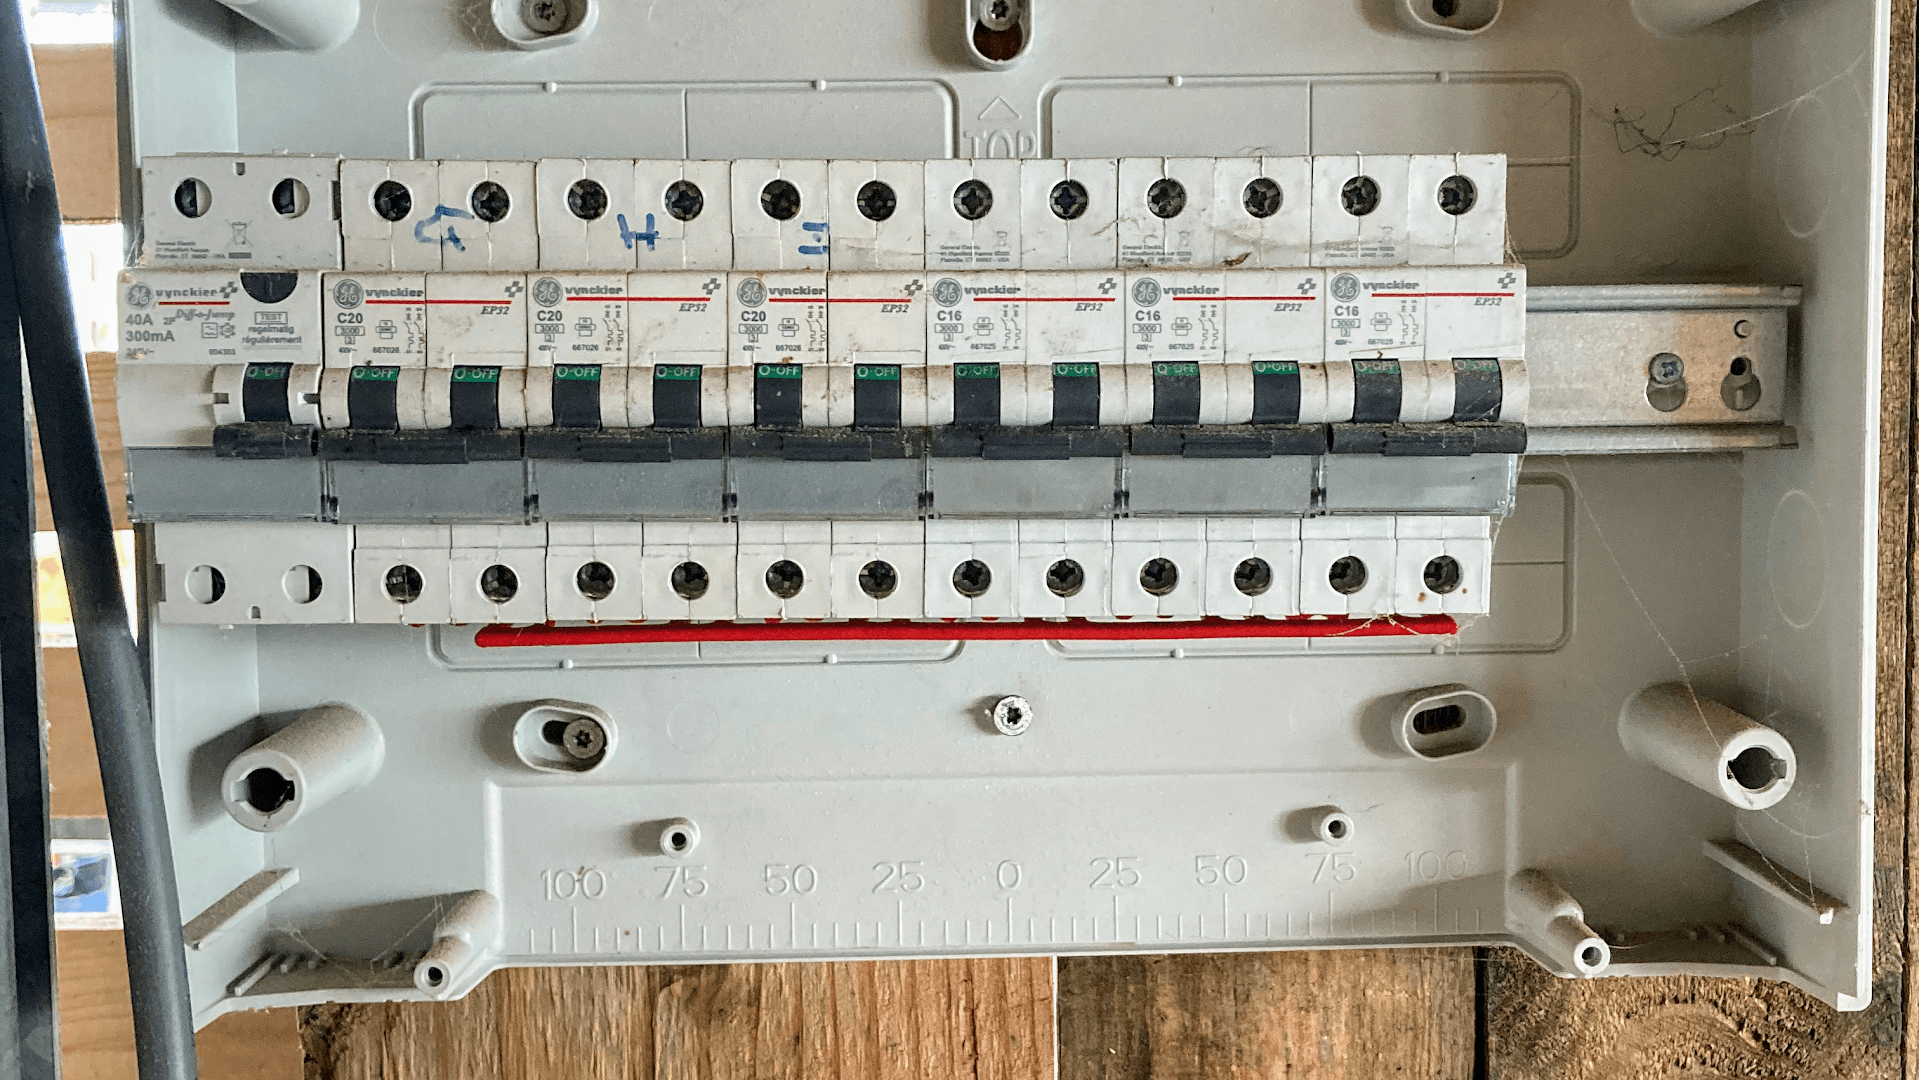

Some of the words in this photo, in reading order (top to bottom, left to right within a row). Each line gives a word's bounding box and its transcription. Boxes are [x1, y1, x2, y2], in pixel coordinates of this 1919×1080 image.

[617, 213, 659, 251] H
[1474, 297, 1502, 306] EP32
[480, 306, 510, 315] EP32
[679, 303, 707, 312] EP32
[881, 304, 909, 313] EP32
[1075, 303, 1103, 312] EP32
[1274, 303, 1302, 312] EP32
[1334, 306, 1359, 317] C16
[125, 313, 153, 325] 40A
[337, 313, 363, 324] C20
[537, 310, 563, 322] C20
[741, 311, 766, 322] C20
[937, 310, 962, 322] C16
[1135, 310, 1161, 322] C16
[539, 324, 560, 333] 3000
[939, 324, 959, 332] 3000
[1137, 324, 1157, 333] 3000
[1336, 320, 1356, 328] 3000
[340, 327, 360, 335] 3000
[744, 325, 763, 333] 3000
[125, 330, 175, 342] 300mA
[541, 868, 606, 900] 100
[655, 866, 709, 898] 75
[764, 863, 817, 896] 50
[872, 860, 926, 894] 25
[996, 858, 1022, 891] 0
[1089, 856, 1142, 889] 25
[1195, 854, 1248, 887] 50
[1305, 852, 1358, 884] 75
[1404, 851, 1468, 881] 100
